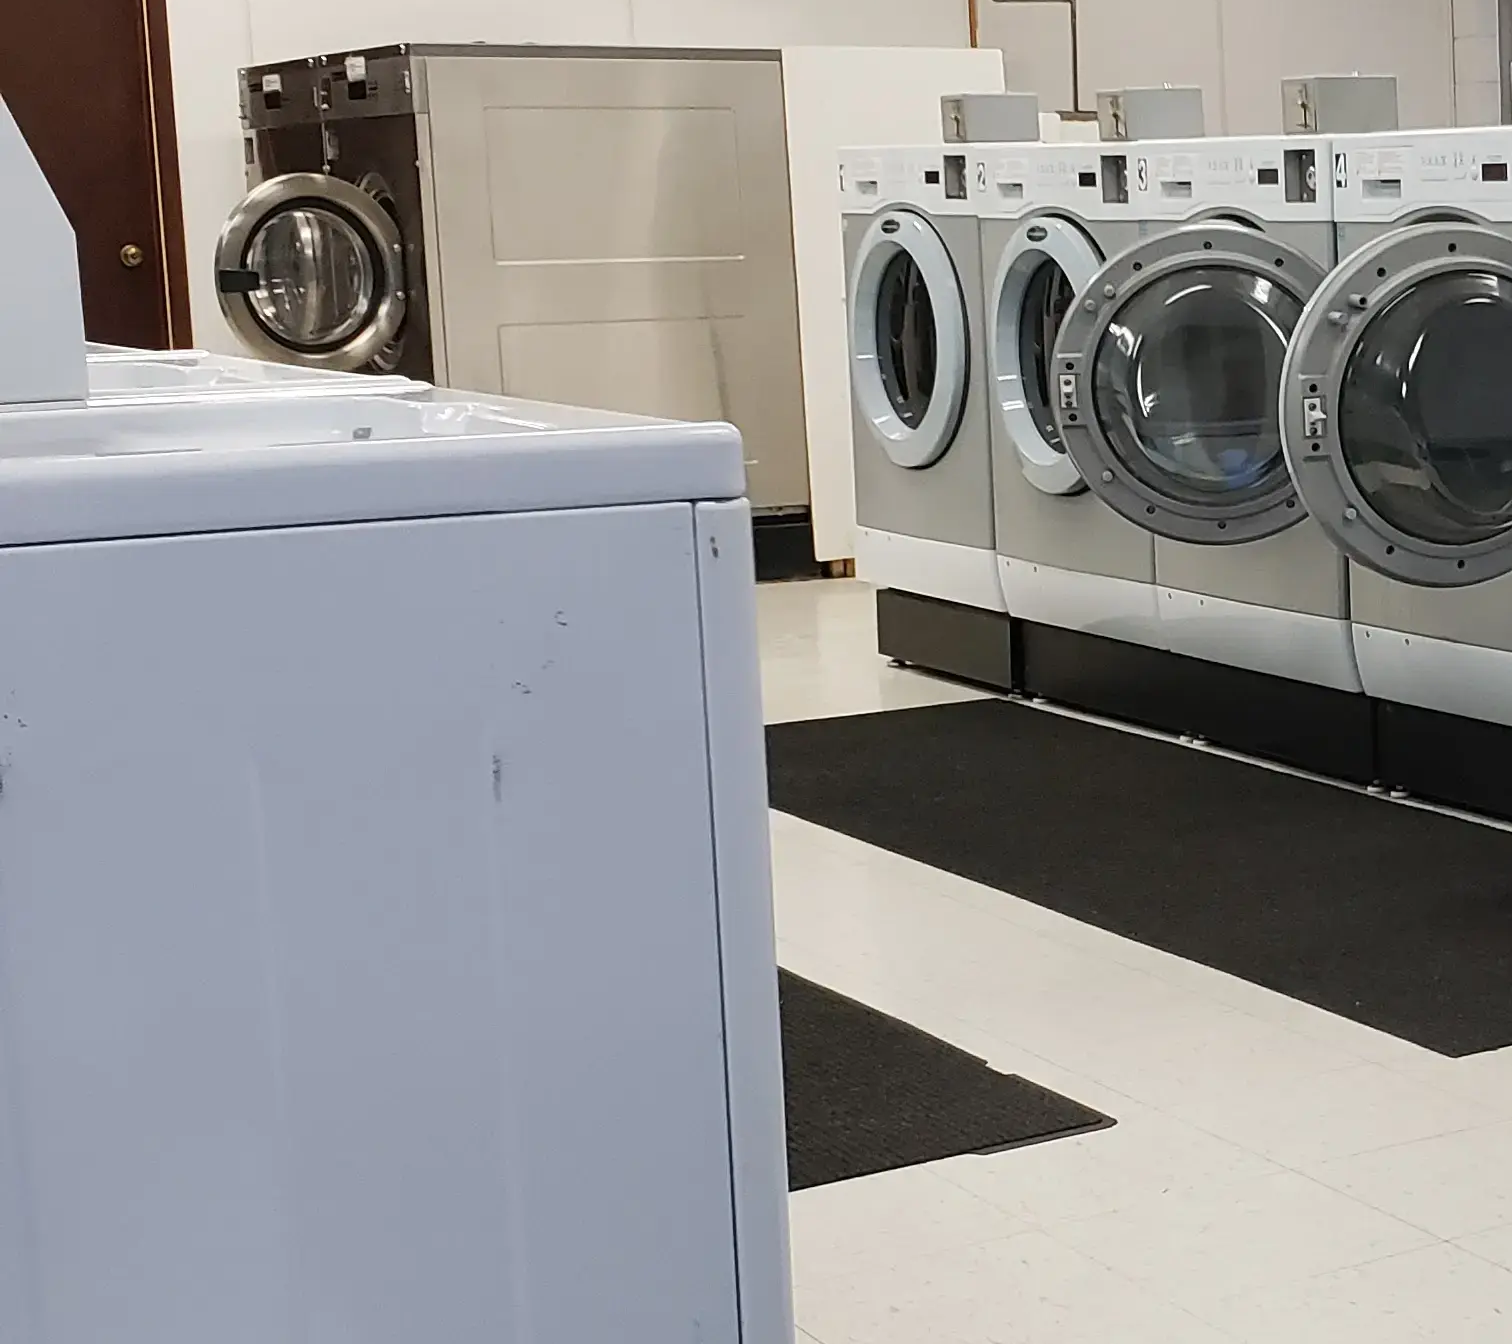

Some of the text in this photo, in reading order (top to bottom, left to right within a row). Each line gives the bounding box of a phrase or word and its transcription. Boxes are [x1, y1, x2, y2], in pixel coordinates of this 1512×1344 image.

[977, 163, 986, 192] 2
[1138, 159, 1147, 191] 3
[1336, 153, 1347, 188] 4
